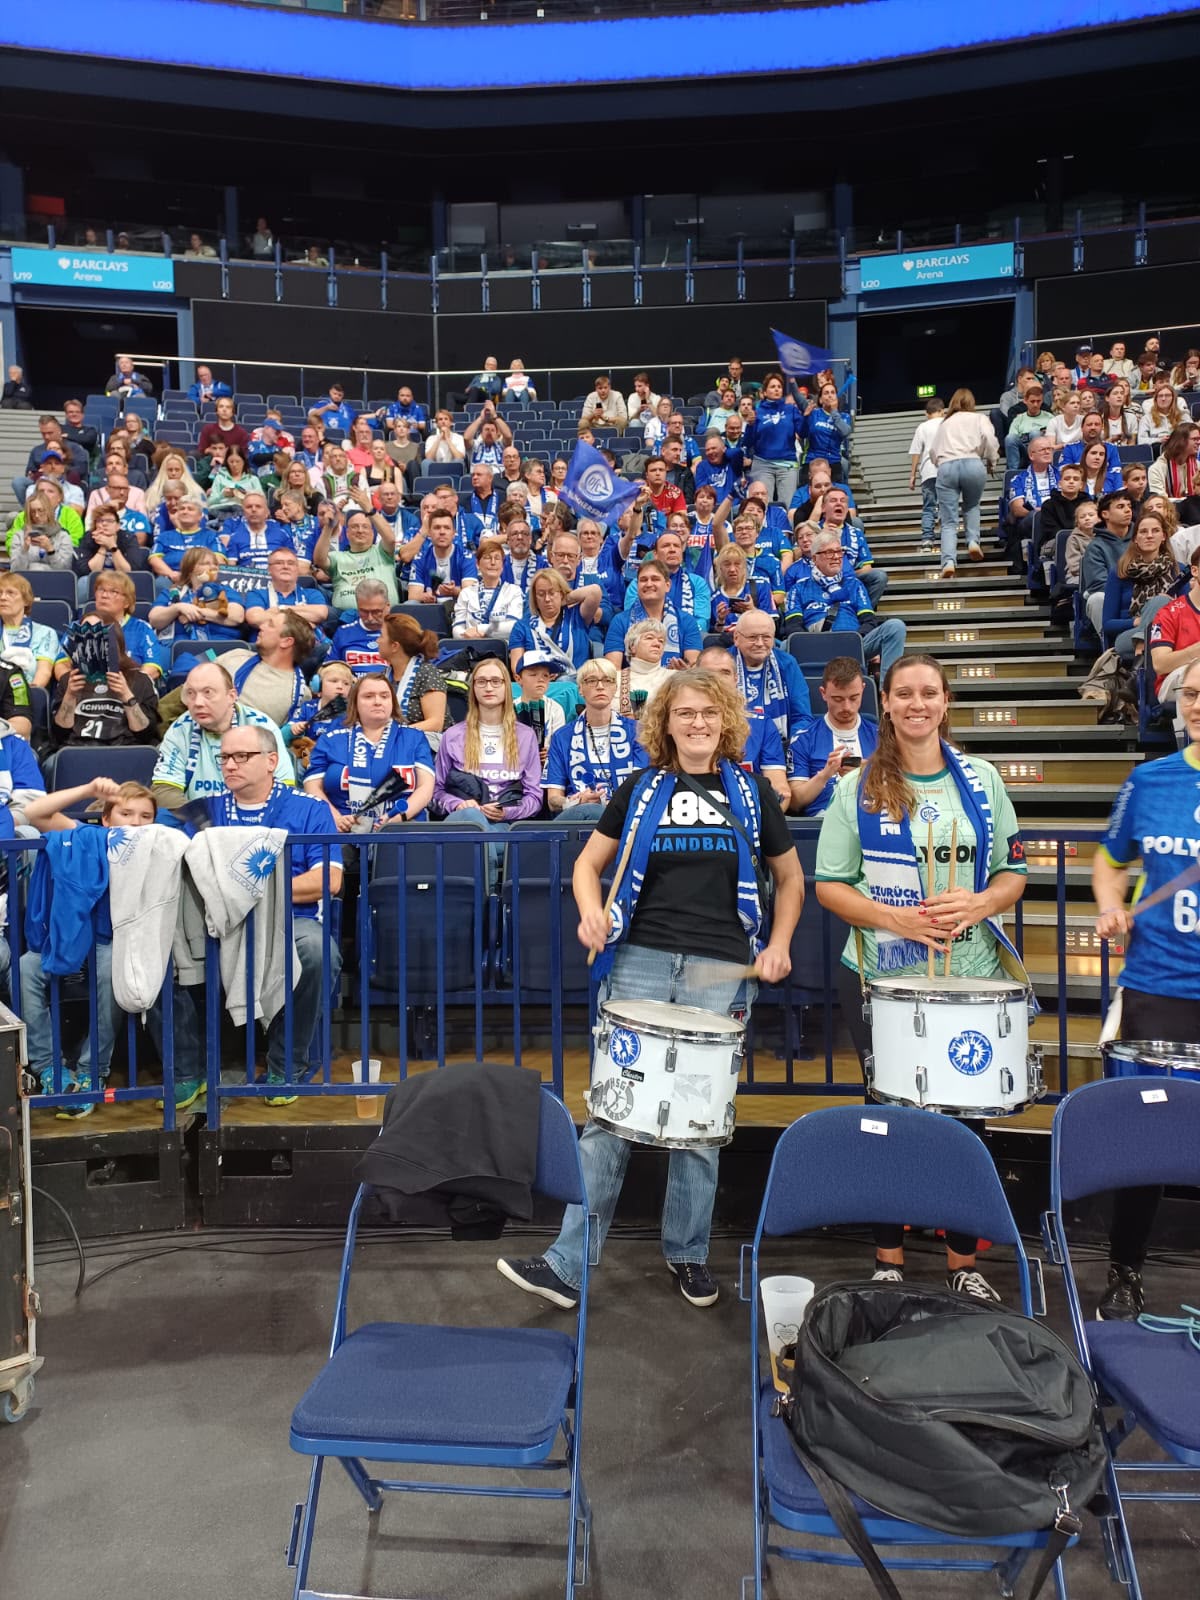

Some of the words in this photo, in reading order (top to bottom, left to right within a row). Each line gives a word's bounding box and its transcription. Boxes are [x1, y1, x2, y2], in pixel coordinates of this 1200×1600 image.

[72, 259, 129, 272] BARCLAYS
[916, 254, 970, 269] BARCLAYS
[73, 271, 103, 283] Arena
[916, 270, 944, 280] Arena
[152, 280, 173, 290] U20
[861, 279, 881, 290] U20
[81, 719, 103, 739] 21
